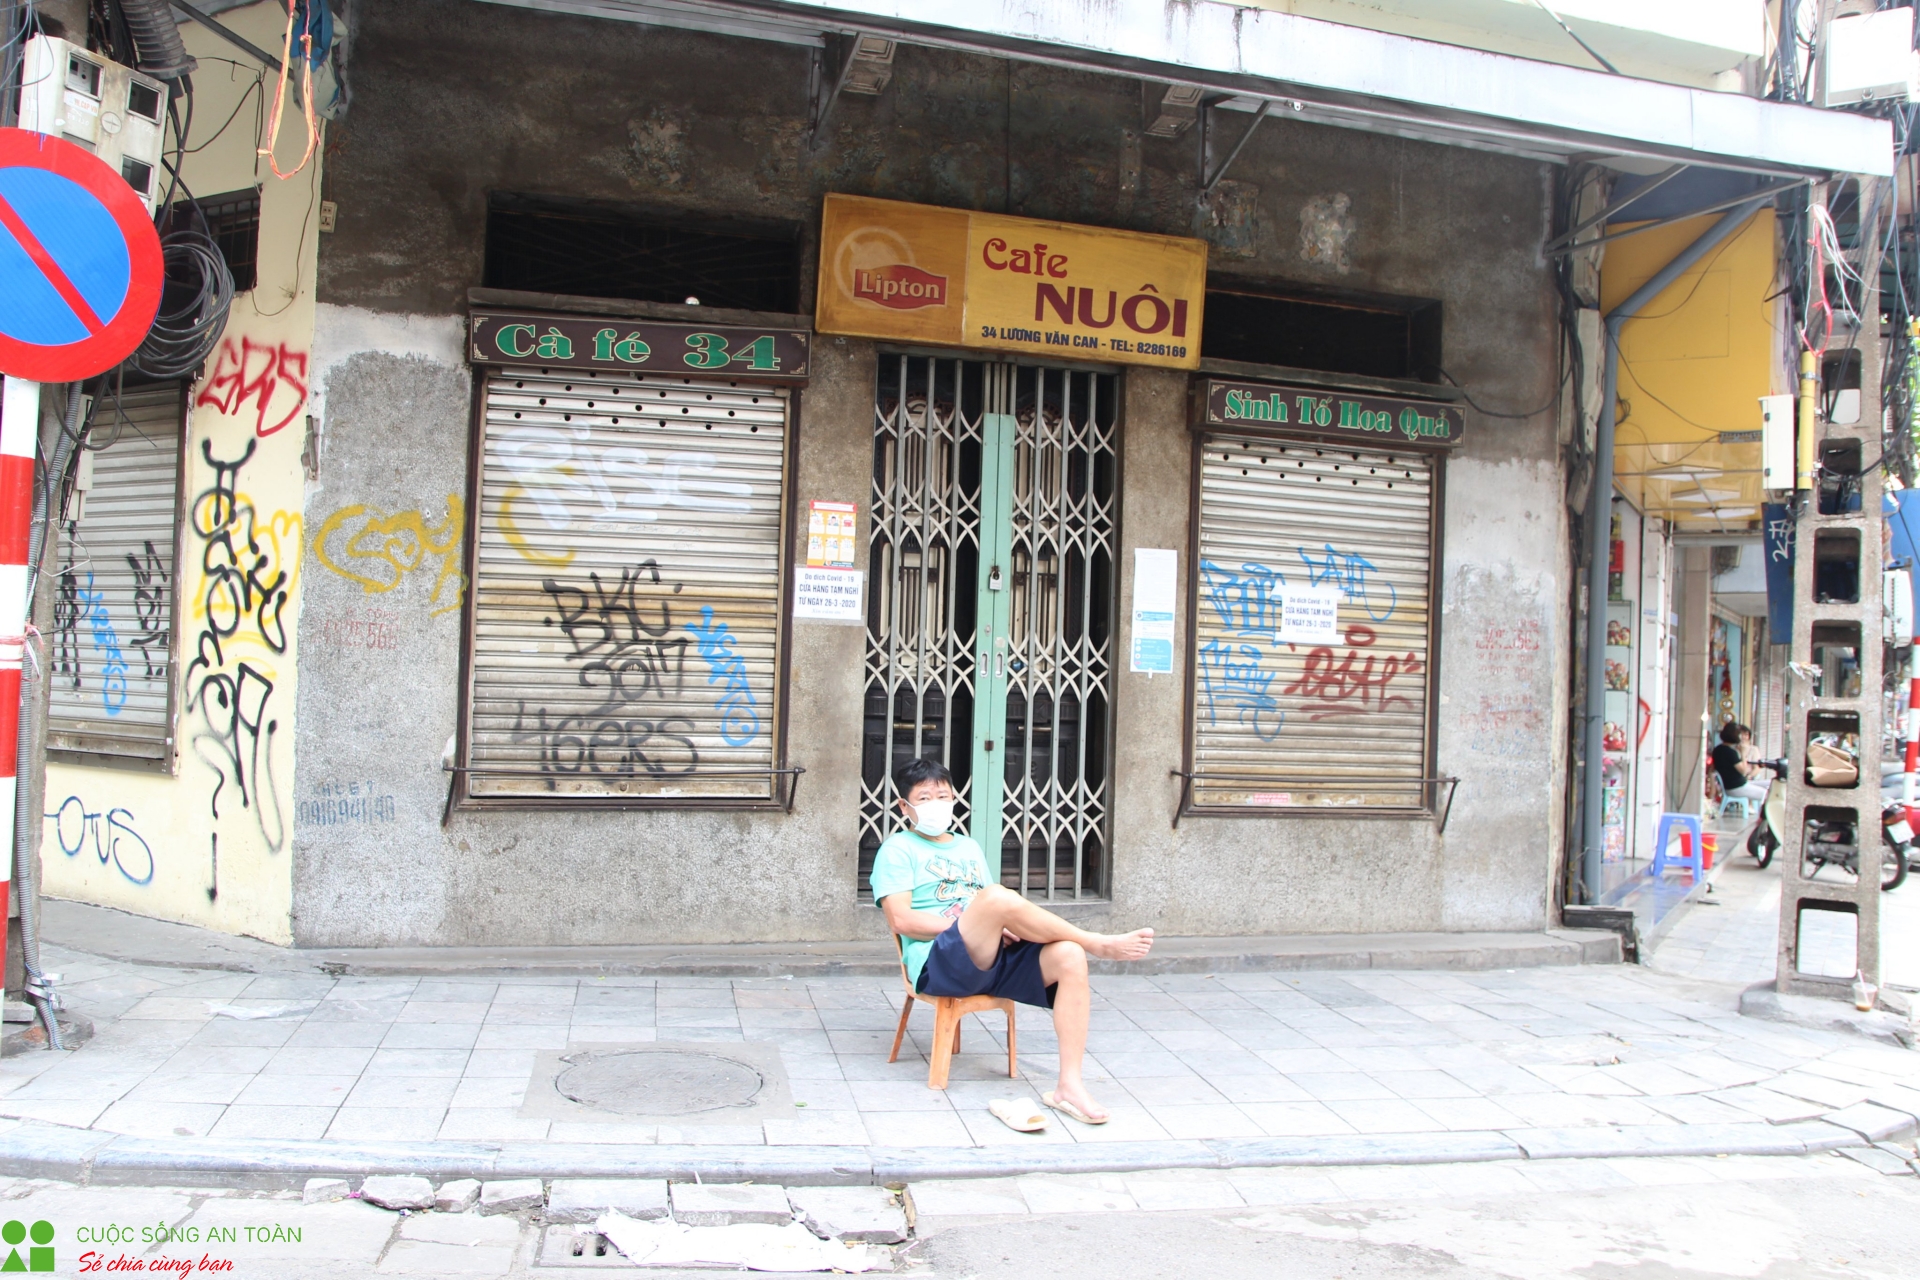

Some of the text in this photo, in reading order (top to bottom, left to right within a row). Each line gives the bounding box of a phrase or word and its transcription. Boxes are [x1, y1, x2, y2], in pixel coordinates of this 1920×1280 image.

[983, 238, 1068, 278] Cafe
[861, 272, 940, 300] Lipton
[1035, 282, 1188, 338] NUÔI
[495, 323, 781, 371] Cà fé 34
[981, 325, 997, 339] 34
[1000, 326, 1041, 343] LƯƠNG
[1045, 330, 1070, 346] VĂN
[1073, 335, 1098, 349] CAN
[1109, 339, 1134, 353] TEL:
[1136, 342, 1187, 358] 8286169
[1224, 389, 1450, 441] Sinh Tố Hoa Quả
[813, 583, 829, 594] HÀNG
[827, 574, 842, 582] Covid
